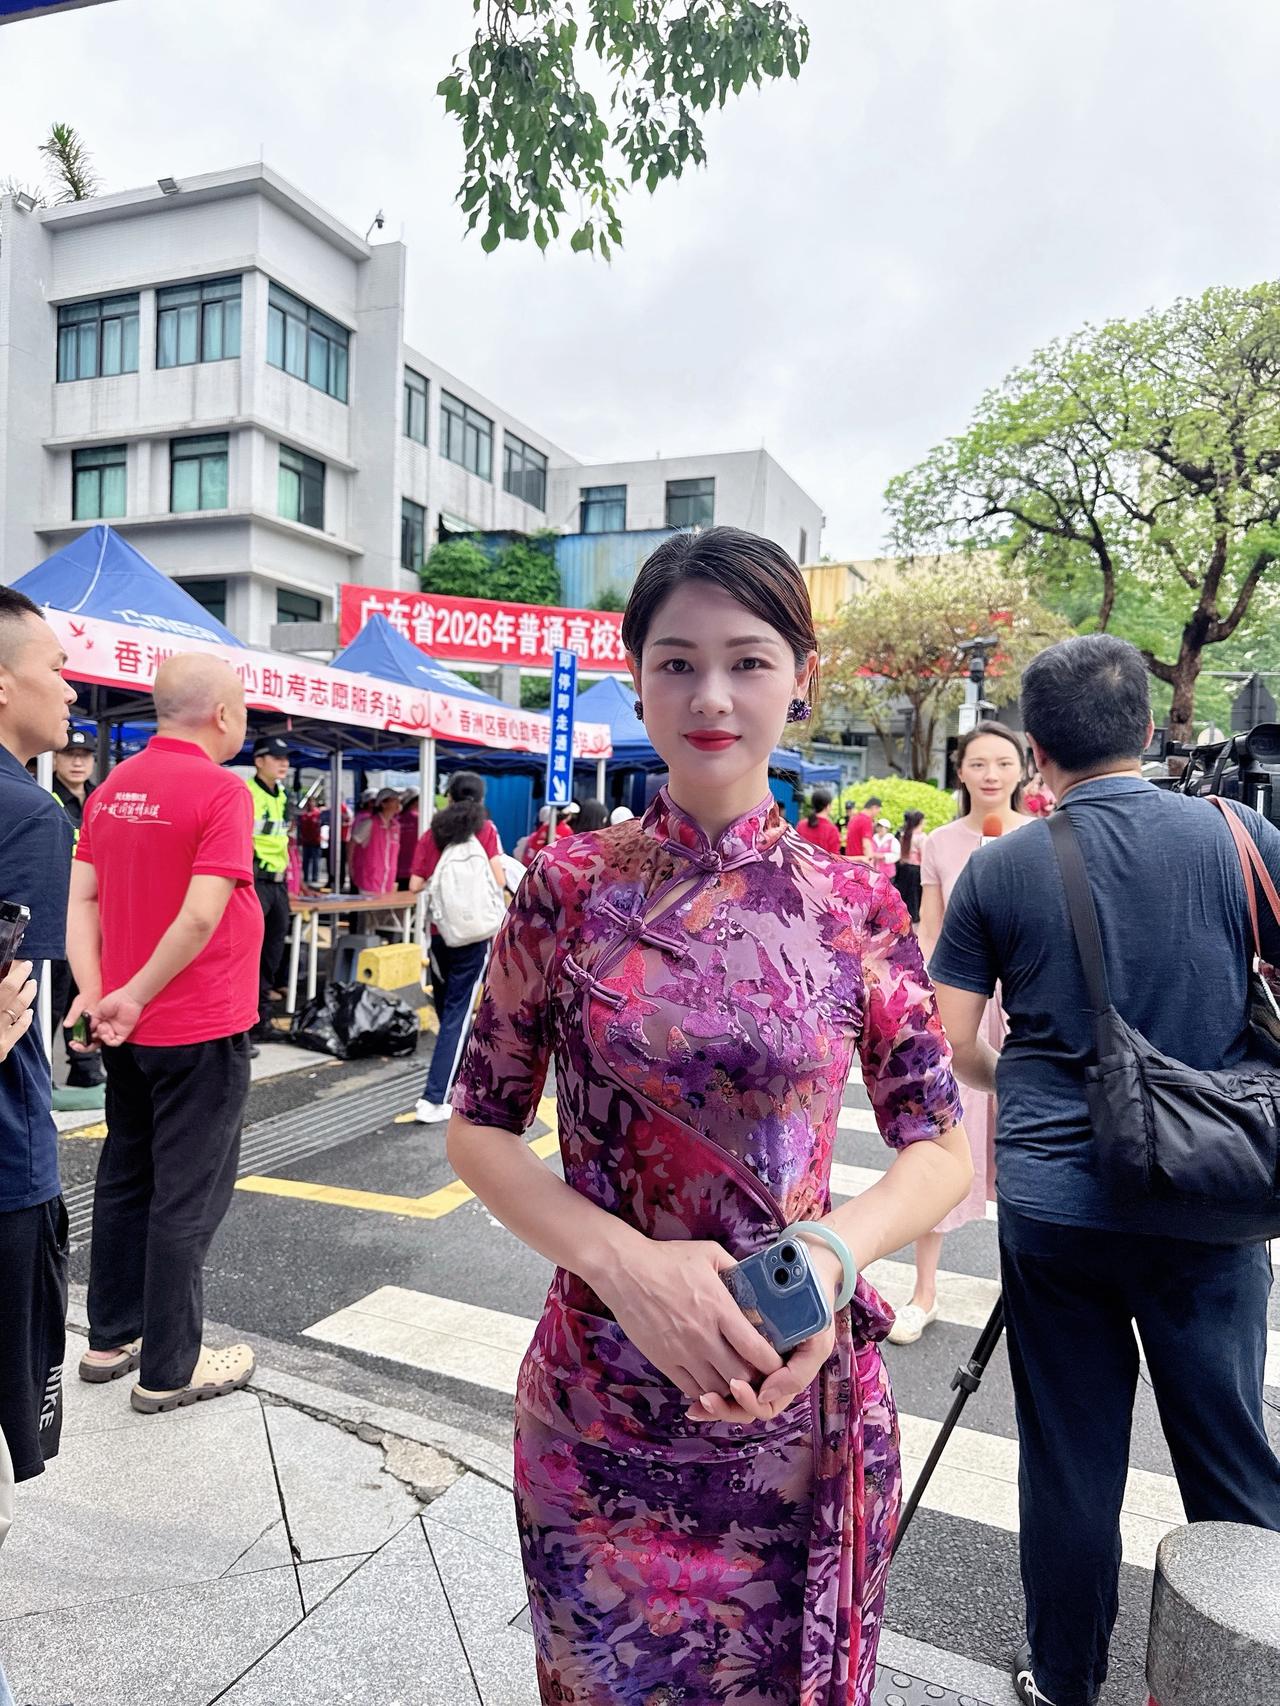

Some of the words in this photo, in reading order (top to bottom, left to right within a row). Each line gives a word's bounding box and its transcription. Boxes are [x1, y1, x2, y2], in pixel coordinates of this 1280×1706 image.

[114, 640, 402, 720] 香洲心助考志愿服务站
[553, 652, 572, 772] 即停即走通道
[38, 1364, 63, 1432] NIKE
